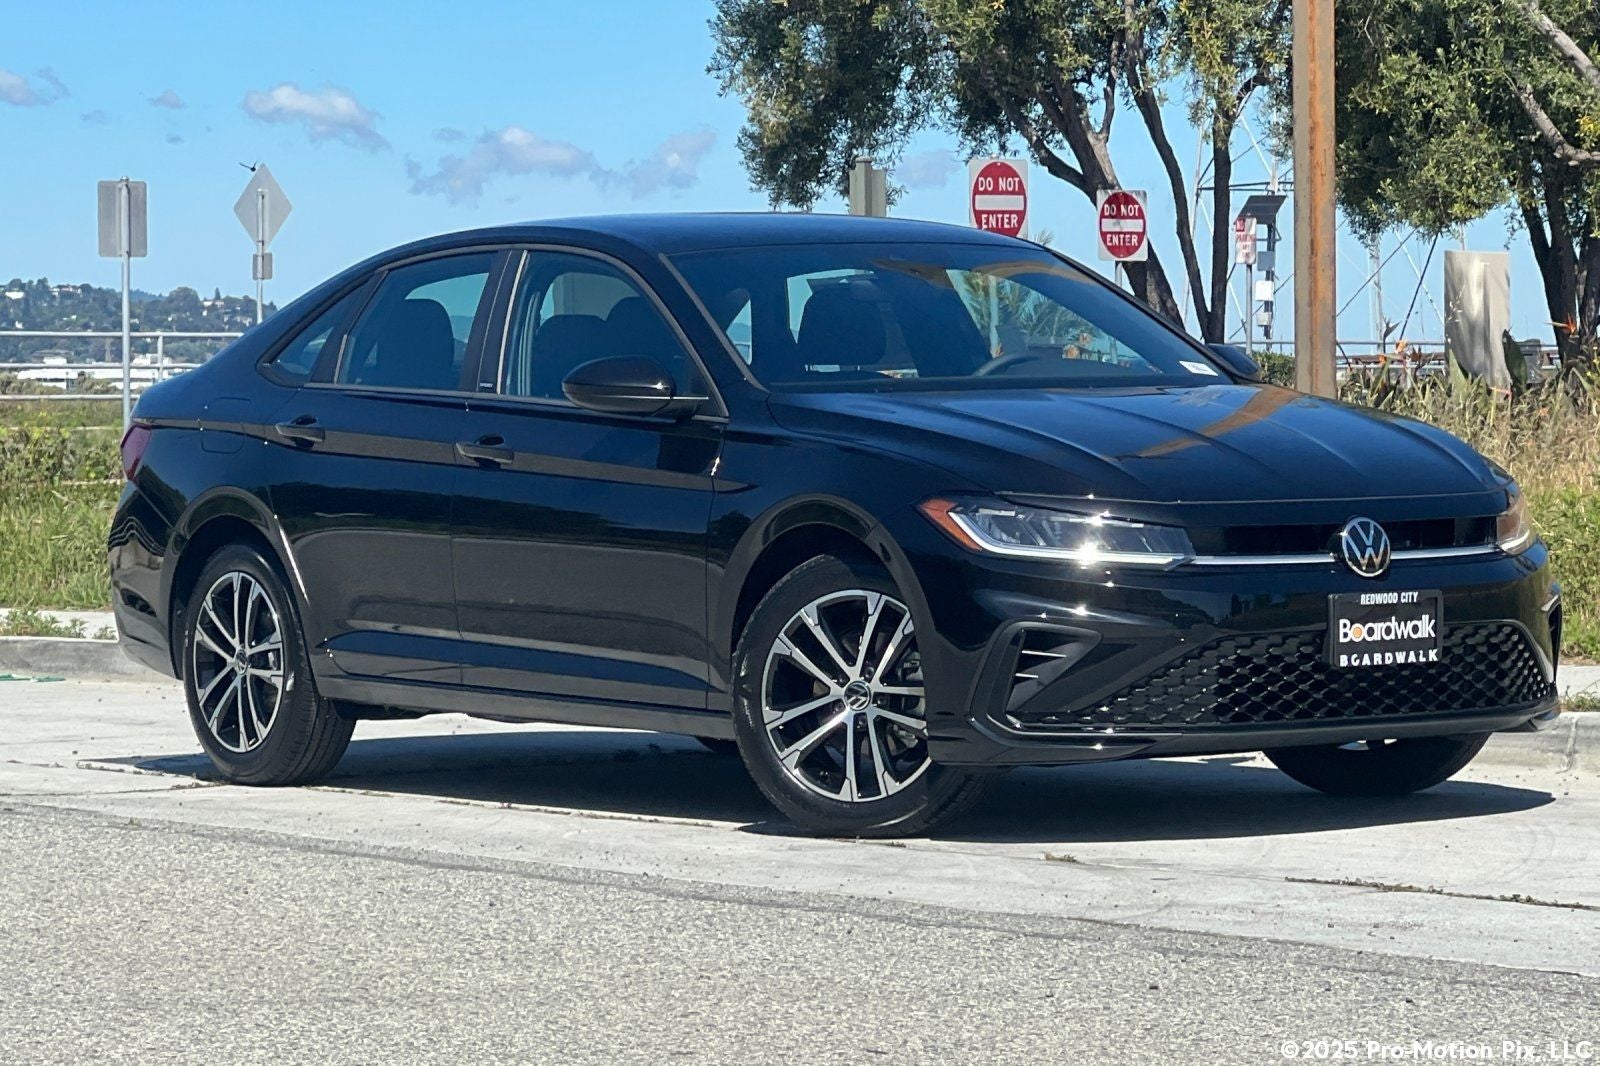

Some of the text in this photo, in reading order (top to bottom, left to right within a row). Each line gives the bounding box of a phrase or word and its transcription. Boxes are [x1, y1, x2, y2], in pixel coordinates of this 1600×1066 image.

[978, 177, 1020, 191] DO NOT
[1104, 204, 1140, 216] DO NOT
[981, 213, 1019, 229] ENTER
[1106, 234, 1139, 246] ENTER
[1360, 591, 1419, 605] REDWOOD CITY
[1339, 614, 1436, 643] Boardwalk
[1339, 649, 1438, 667] BOARDWALK
